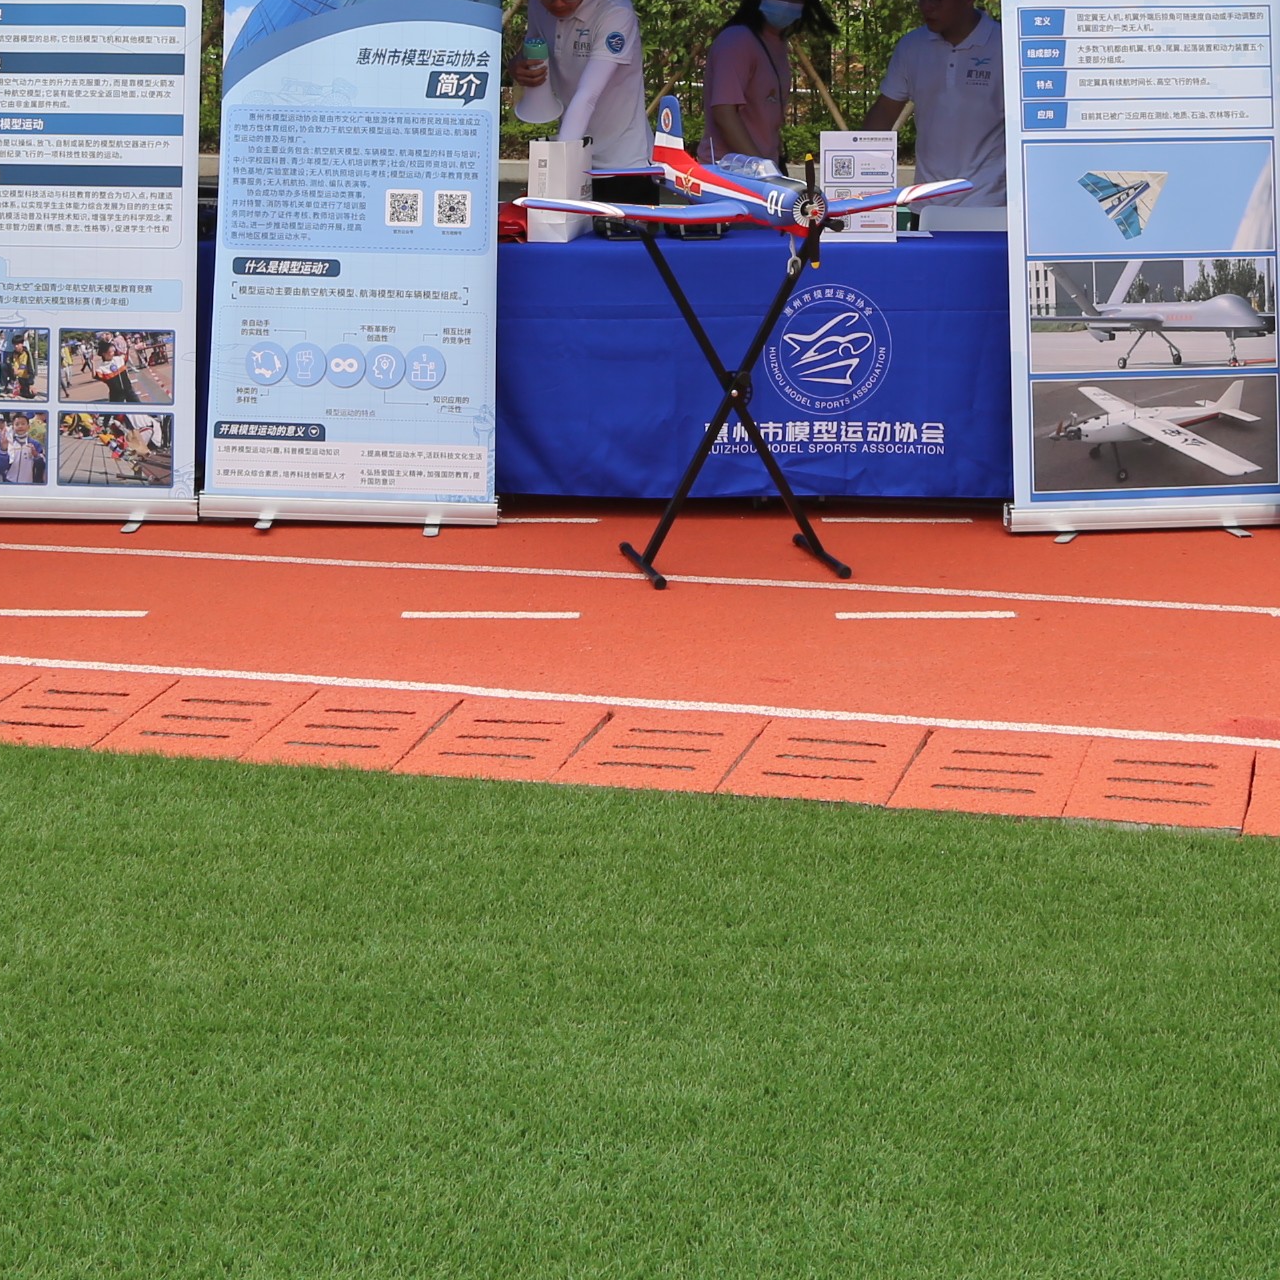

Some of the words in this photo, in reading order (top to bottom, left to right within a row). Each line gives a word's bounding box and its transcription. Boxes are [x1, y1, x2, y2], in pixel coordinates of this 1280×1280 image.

[1034, 17, 1050, 26] 定义
[356, 48, 491, 67] 惠州市模型运动协会
[1027, 49, 1060, 58] 组成部分
[436, 74, 482, 96] 简介
[1037, 80, 1053, 90] 特点
[1037, 110, 1054, 119] 应用
[765, 189, 786, 215] 01
[783, 289, 873, 317] 惠州市模型运动协会
[769, 347, 786, 386] HUIZHOU
[784, 386, 811, 407] MODEL
[815, 398, 850, 409] SPORTS
[852, 347, 885, 400] ASSOCIATION
[219, 425, 306, 437] 开展模型运动的意义
[808, 443, 857, 453] SPORTS
[861, 444, 945, 455] ASSOCIATION
